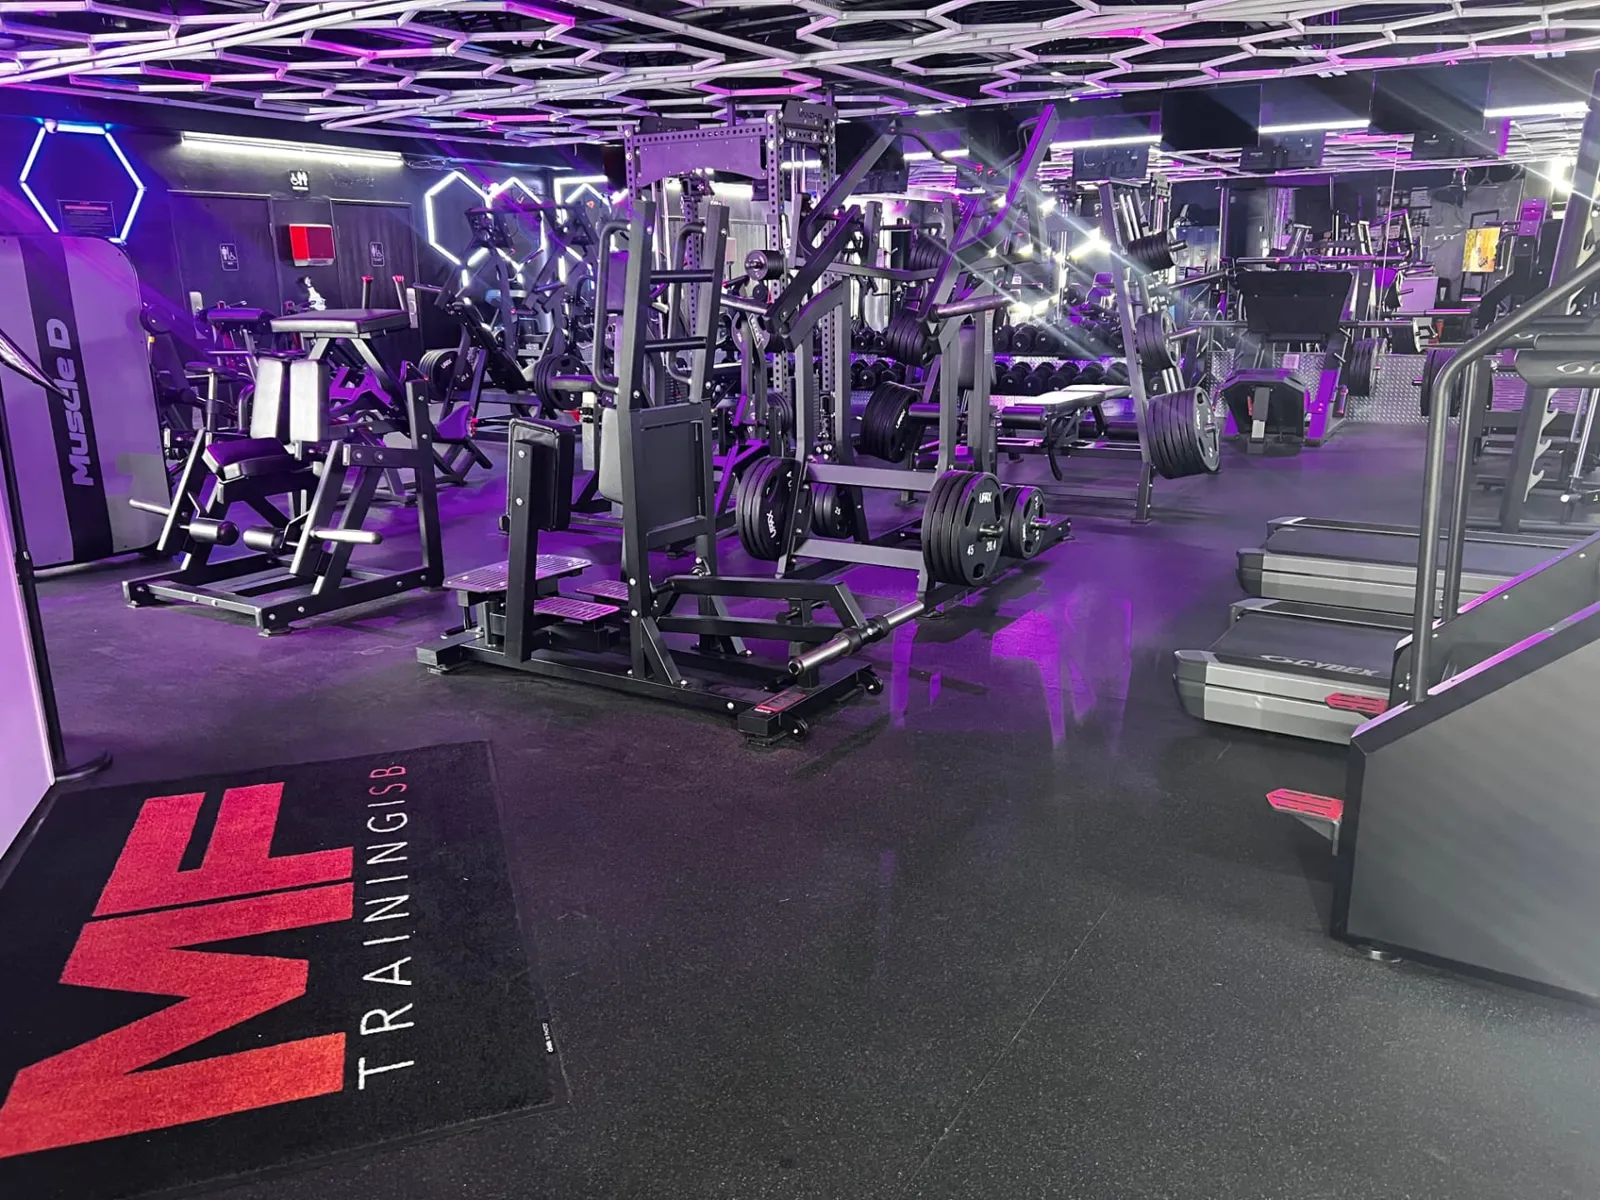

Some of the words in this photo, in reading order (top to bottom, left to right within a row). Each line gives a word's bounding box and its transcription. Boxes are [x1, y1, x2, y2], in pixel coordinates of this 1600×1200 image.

[46, 318, 72, 350] D
[1293, 659, 1380, 677] CYBEX
[0, 782, 354, 1158] MF
